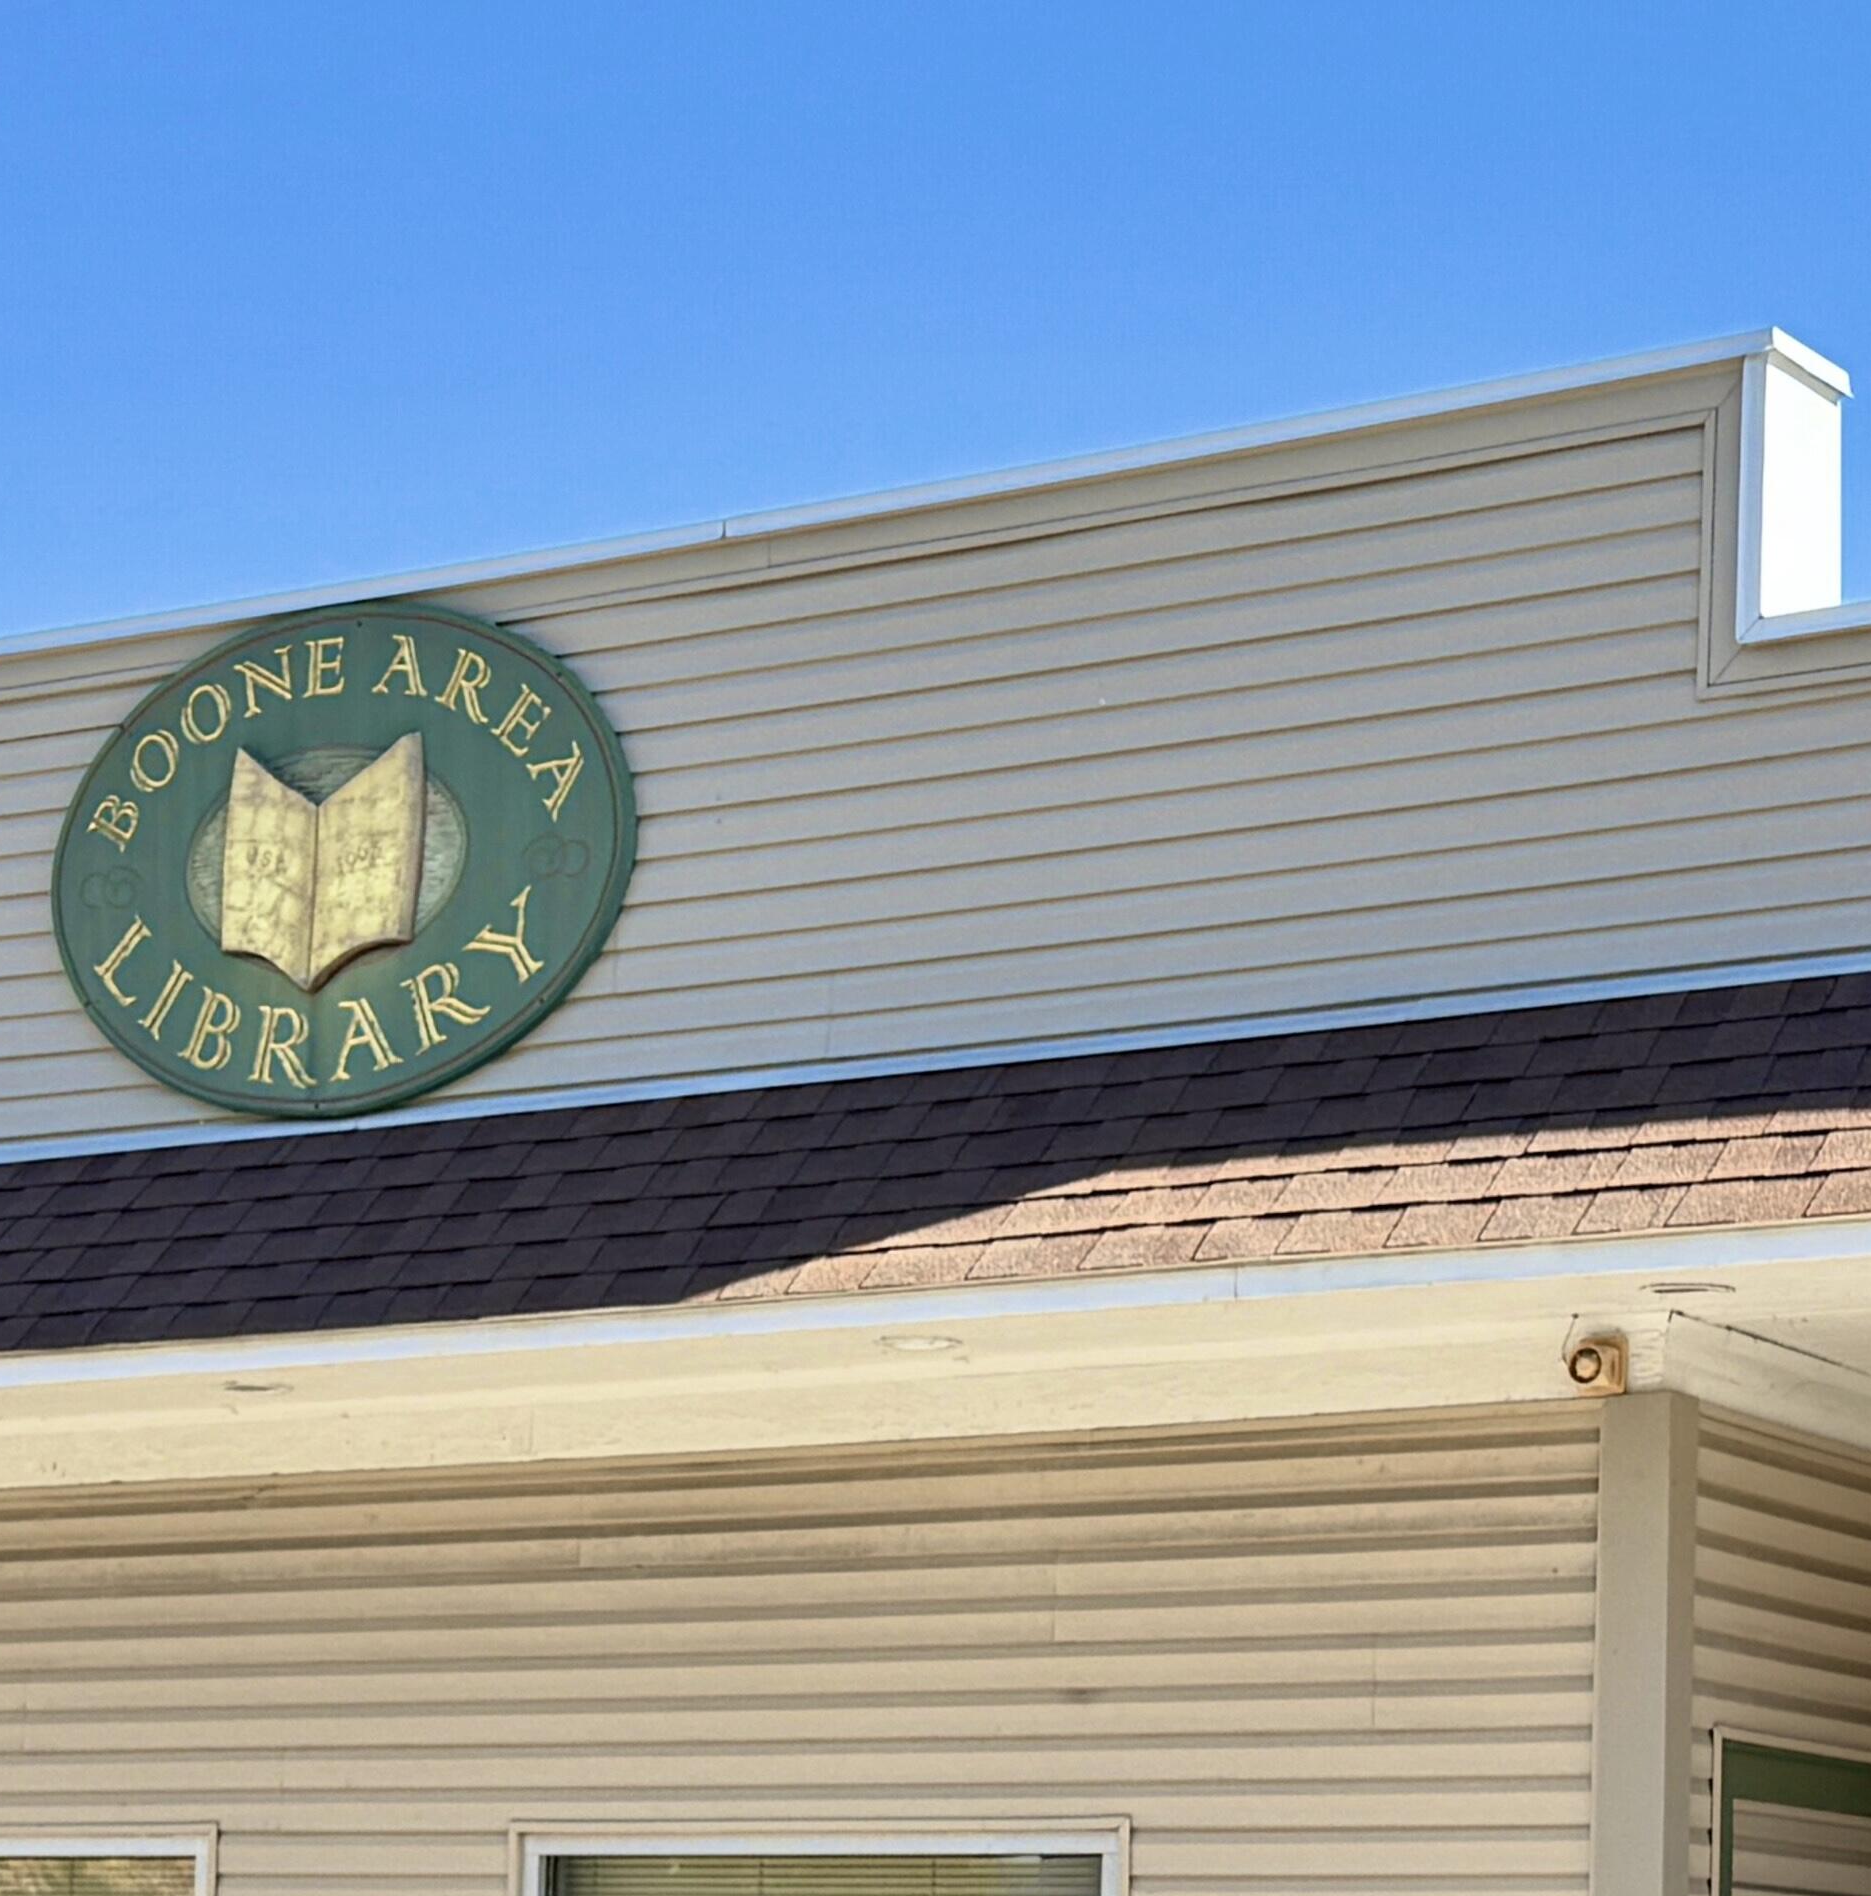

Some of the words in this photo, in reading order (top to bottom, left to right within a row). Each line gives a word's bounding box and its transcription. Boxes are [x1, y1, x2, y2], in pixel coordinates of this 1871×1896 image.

[88, 636, 346, 853] BOONE
[372, 634, 586, 823] AREA
[93, 885, 545, 1090] LIBRARY
